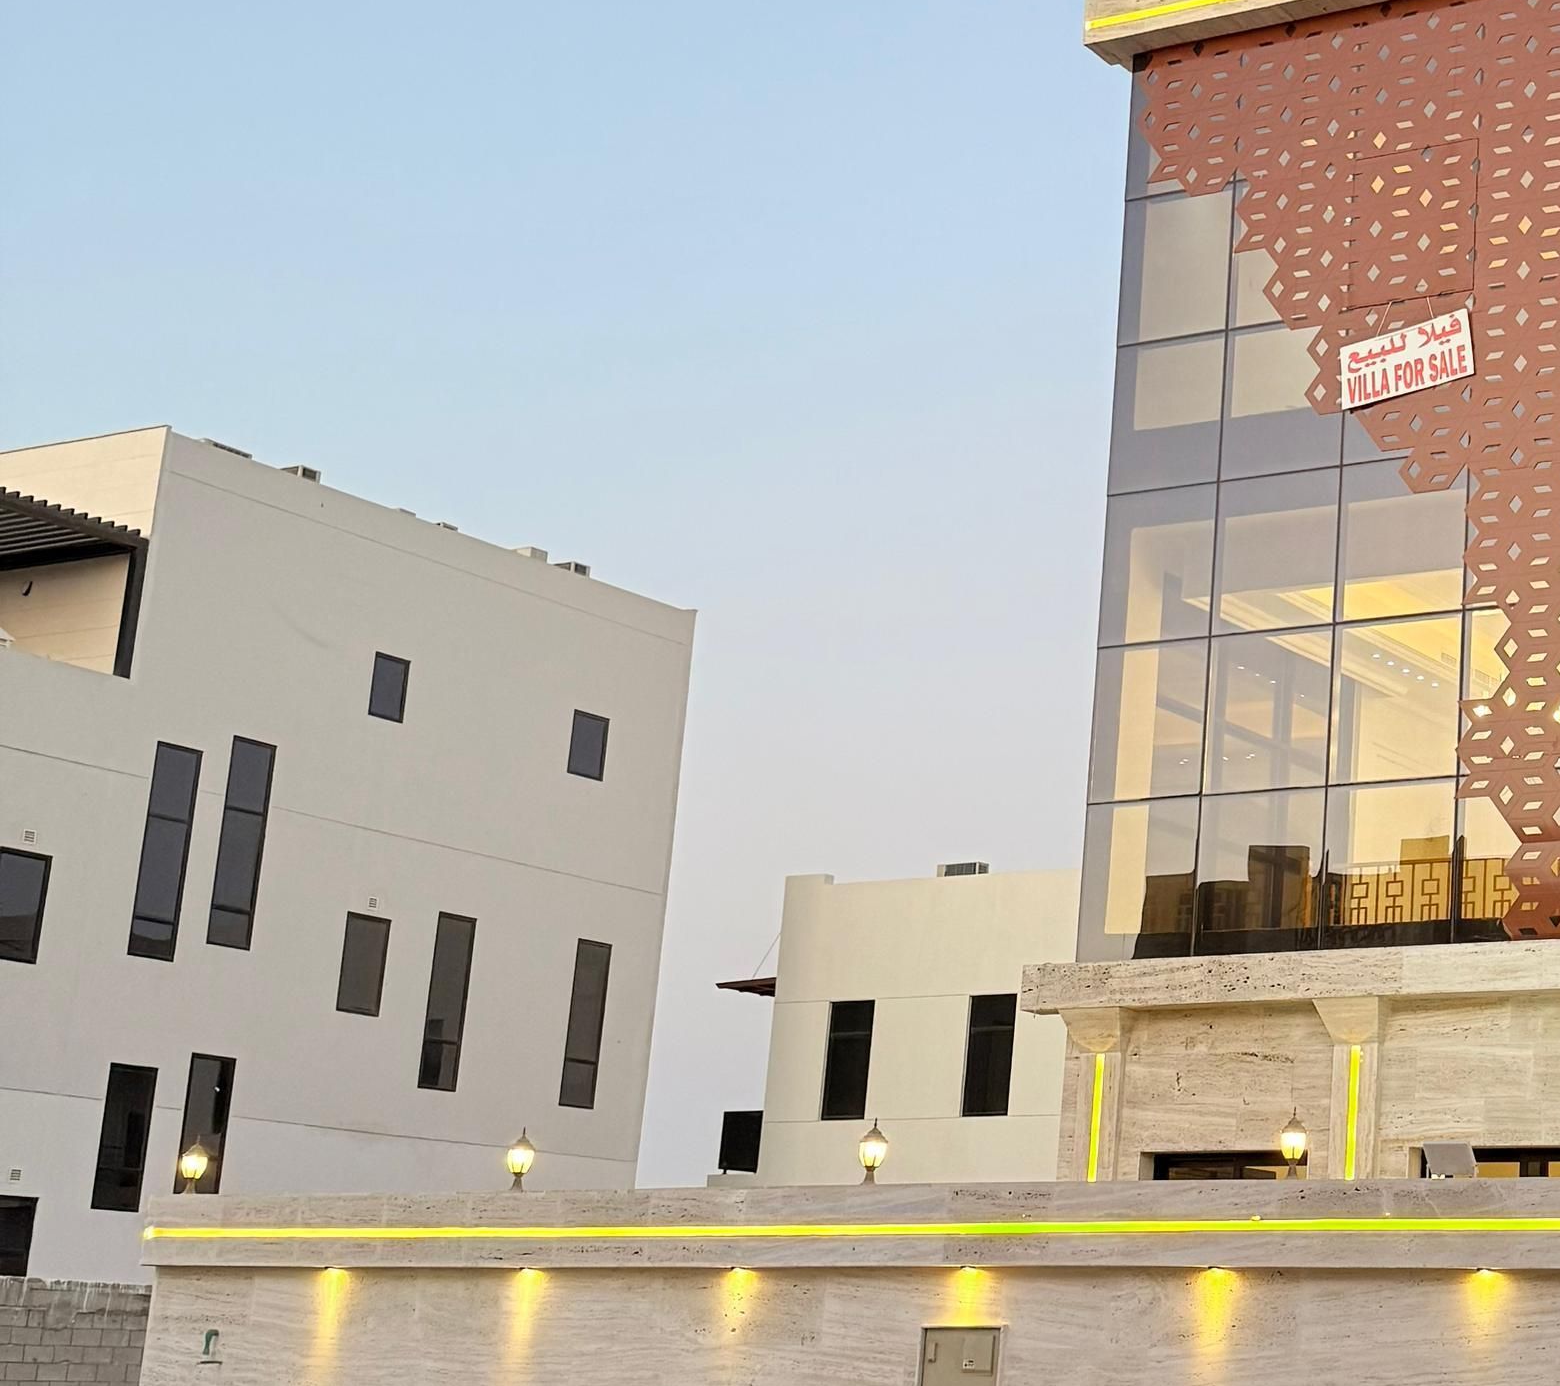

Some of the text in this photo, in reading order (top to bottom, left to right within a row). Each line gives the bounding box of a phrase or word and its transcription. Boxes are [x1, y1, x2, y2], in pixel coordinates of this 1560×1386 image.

[1347, 314, 1462, 373] فيلا للبيع
[1347, 344, 1467, 404] VILLA FOR SALE
